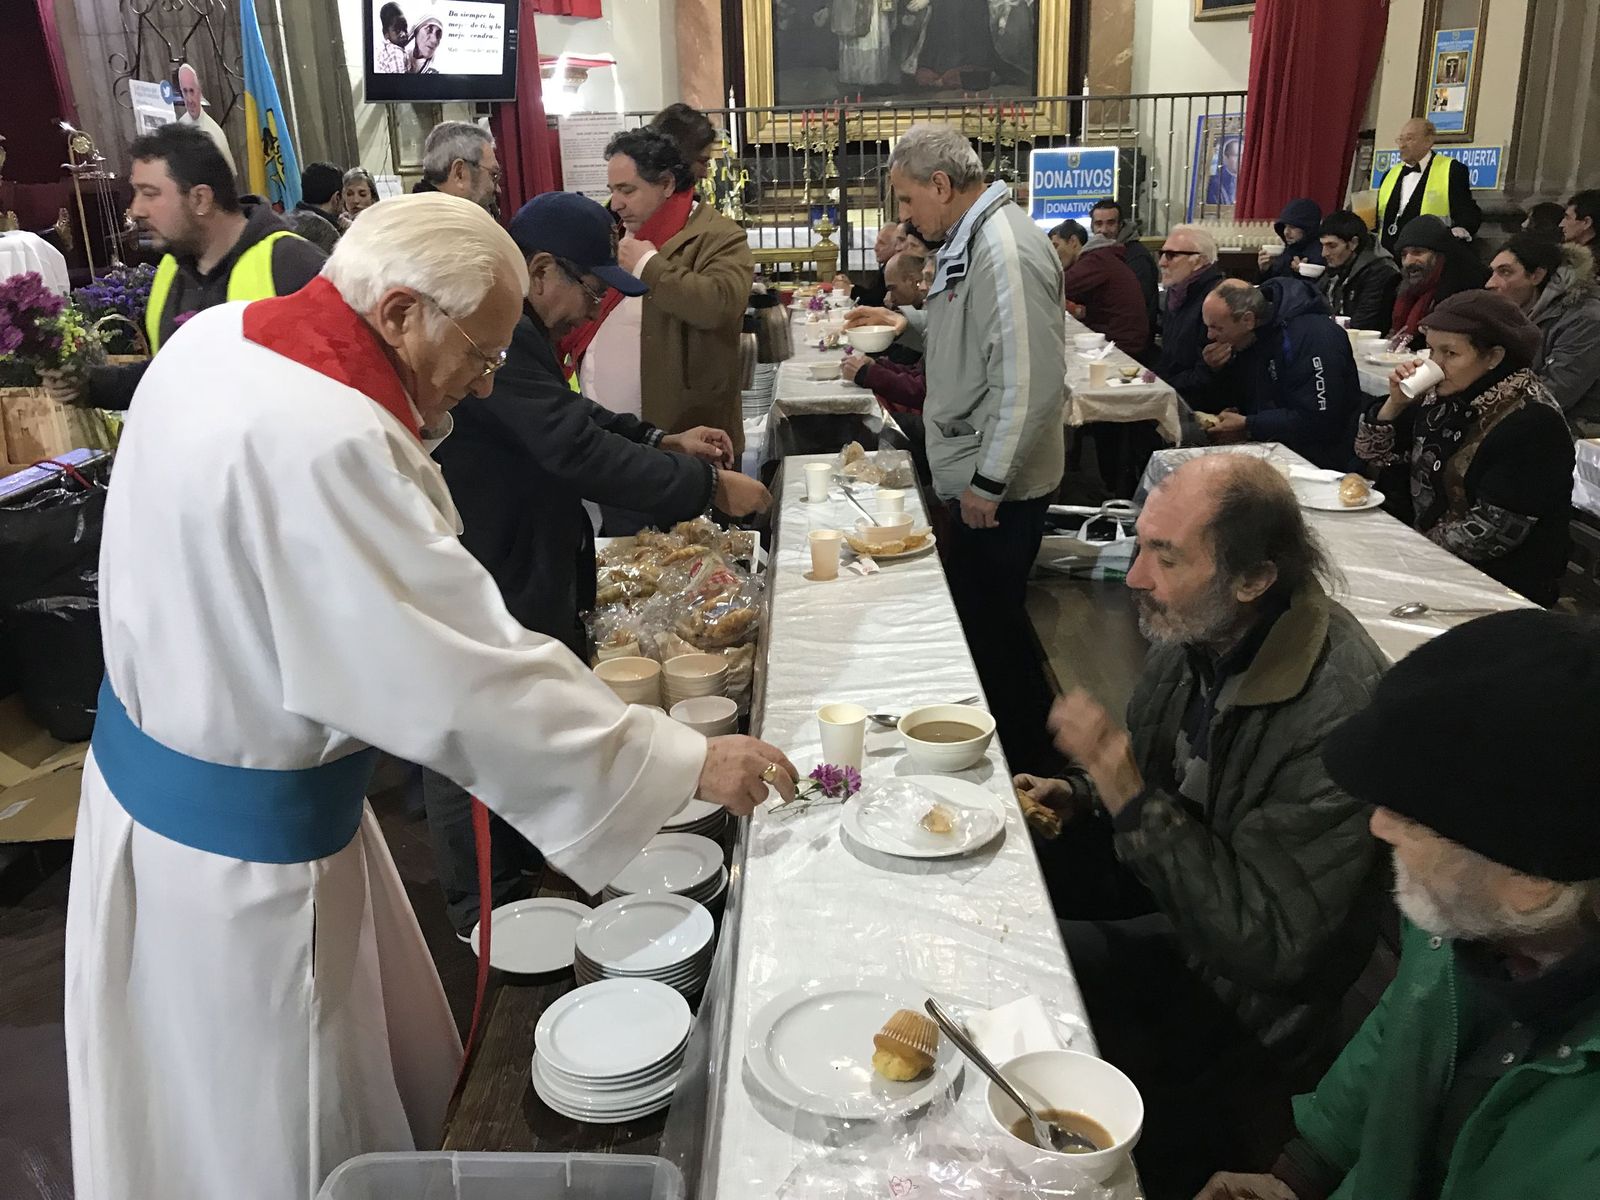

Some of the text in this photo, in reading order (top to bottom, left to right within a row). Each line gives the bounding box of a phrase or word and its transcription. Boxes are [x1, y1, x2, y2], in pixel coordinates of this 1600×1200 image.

[1462, 150, 1497, 167] PUERTA
[1034, 169, 1112, 189] DONATIVOS
[1047, 202, 1097, 213] DONATIVO
[1312, 356, 1326, 410] GIVOVA
